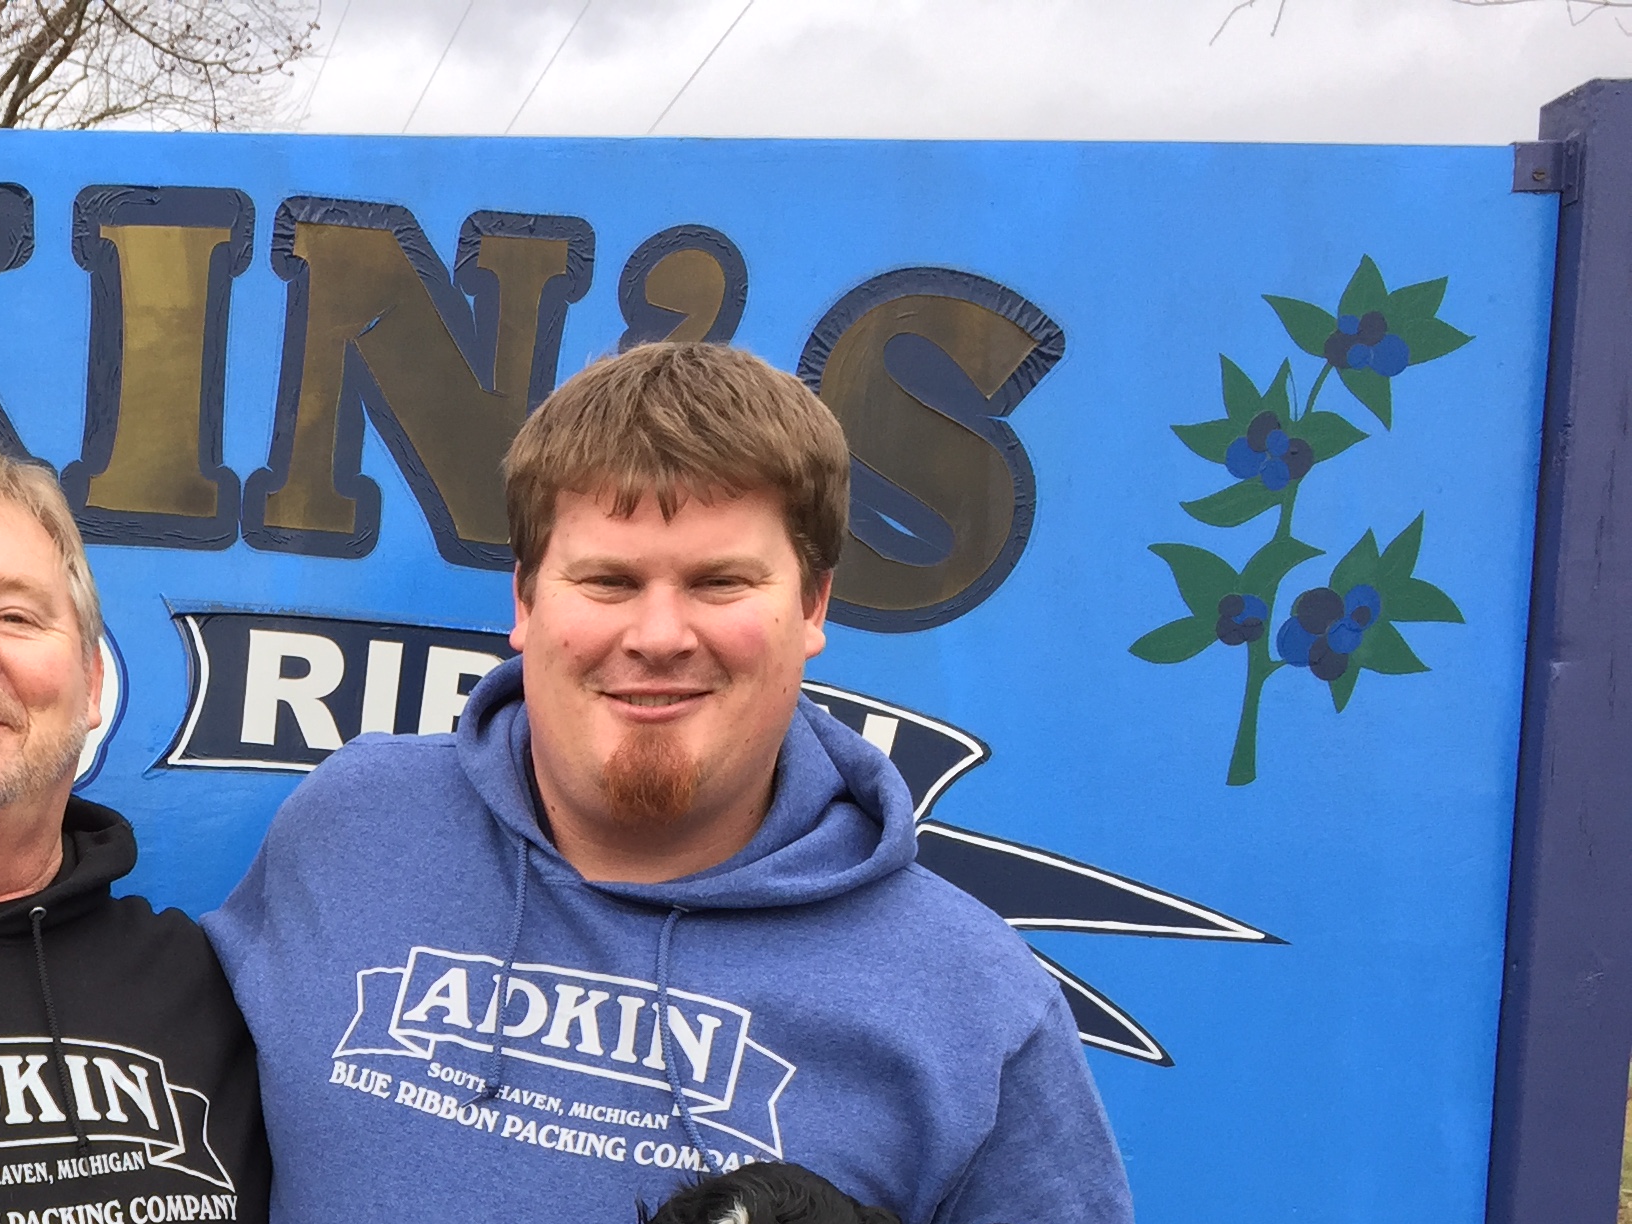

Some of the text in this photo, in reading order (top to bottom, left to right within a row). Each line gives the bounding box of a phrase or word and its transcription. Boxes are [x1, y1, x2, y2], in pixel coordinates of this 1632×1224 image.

[402, 967, 723, 1084] ADKIN
[329, 1060, 393, 1099] BLUE
[394, 1080, 500, 1132] RIBBON
[500, 1114, 627, 1162] PACKING
[568, 1101, 669, 1130] MICHIGAN
[57, 1151, 146, 1180] MICHIGAN
